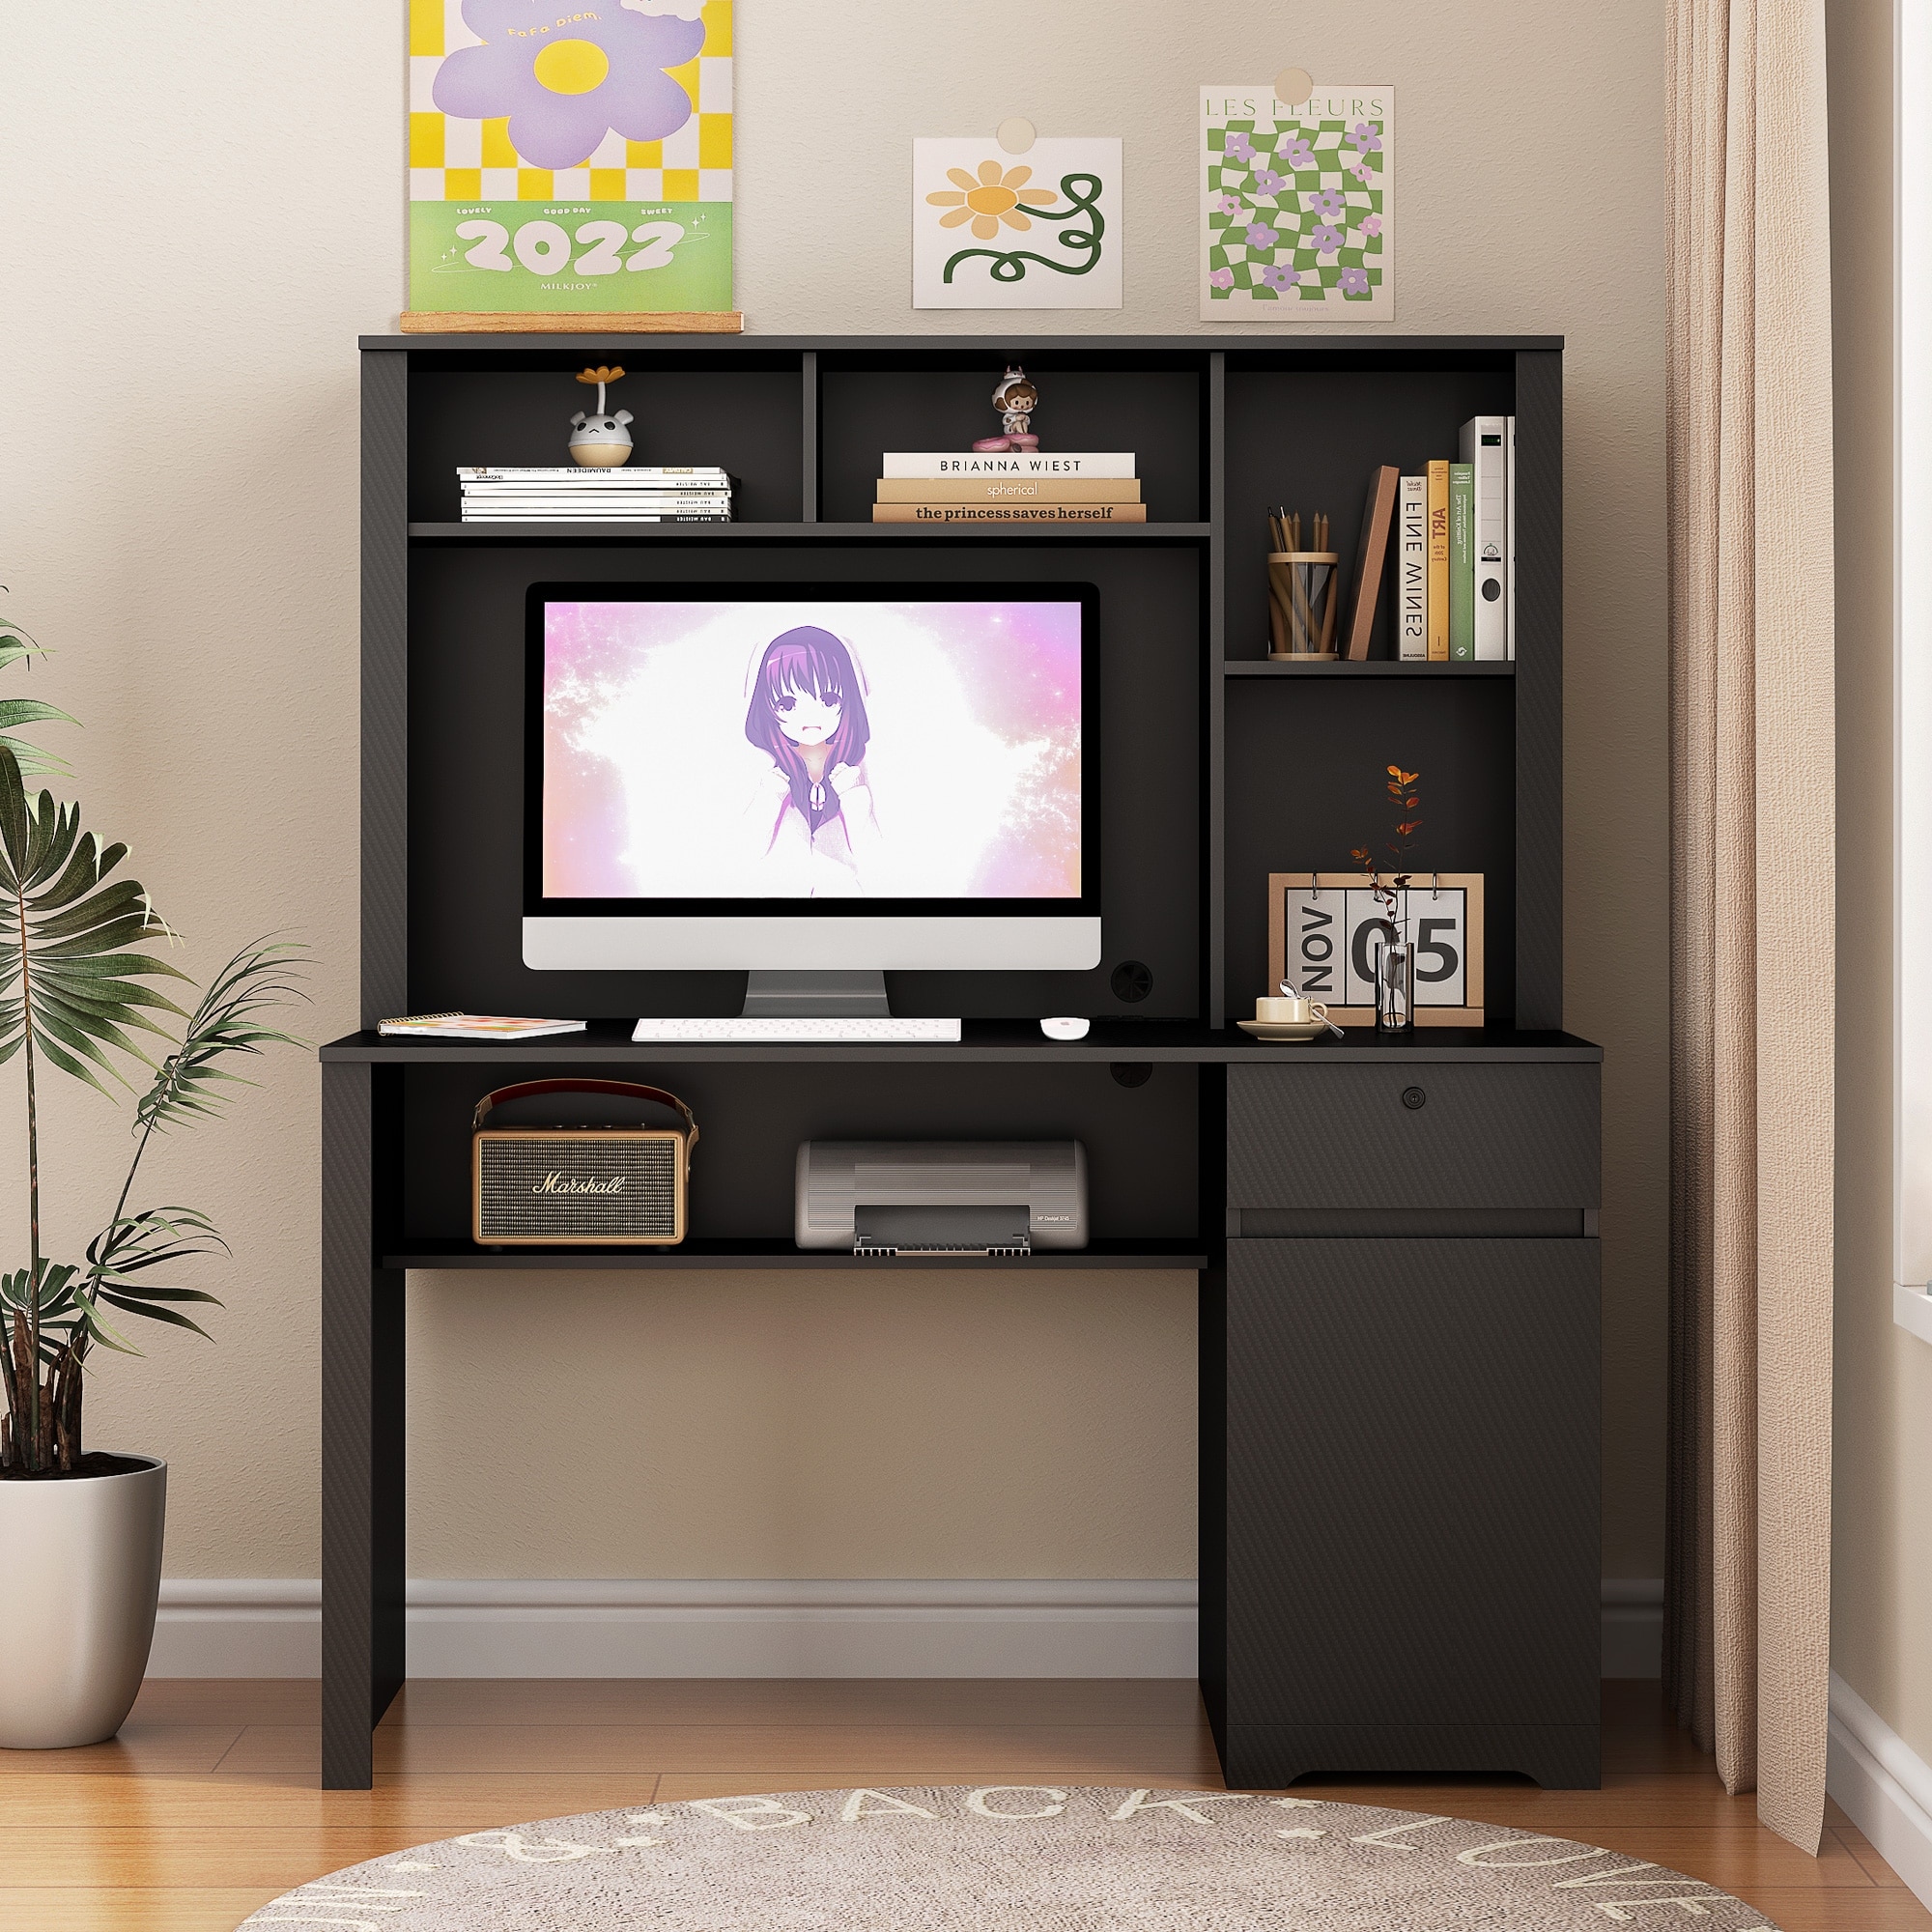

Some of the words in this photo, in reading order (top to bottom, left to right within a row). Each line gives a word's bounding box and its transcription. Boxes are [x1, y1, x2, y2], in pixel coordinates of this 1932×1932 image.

[1207, 99, 1257, 116] LES
[1272, 99, 1383, 116] FLEURS
[456, 207, 493, 215] LOVELY
[455, 219, 685, 276] 2022
[940, 460, 1021, 471] BRIANNA
[1030, 460, 1082, 471] WIEST
[986, 482, 1038, 498] spherical
[916, 506, 942, 519] the
[944, 506, 1011, 522] princess
[1012, 509, 1055, 519] saves
[1057, 506, 1114, 519] herself
[1301, 906, 1333, 992] NOV
[532, 1171, 626, 1194] Marshall
[687, 1786, 1260, 1831] BACK
